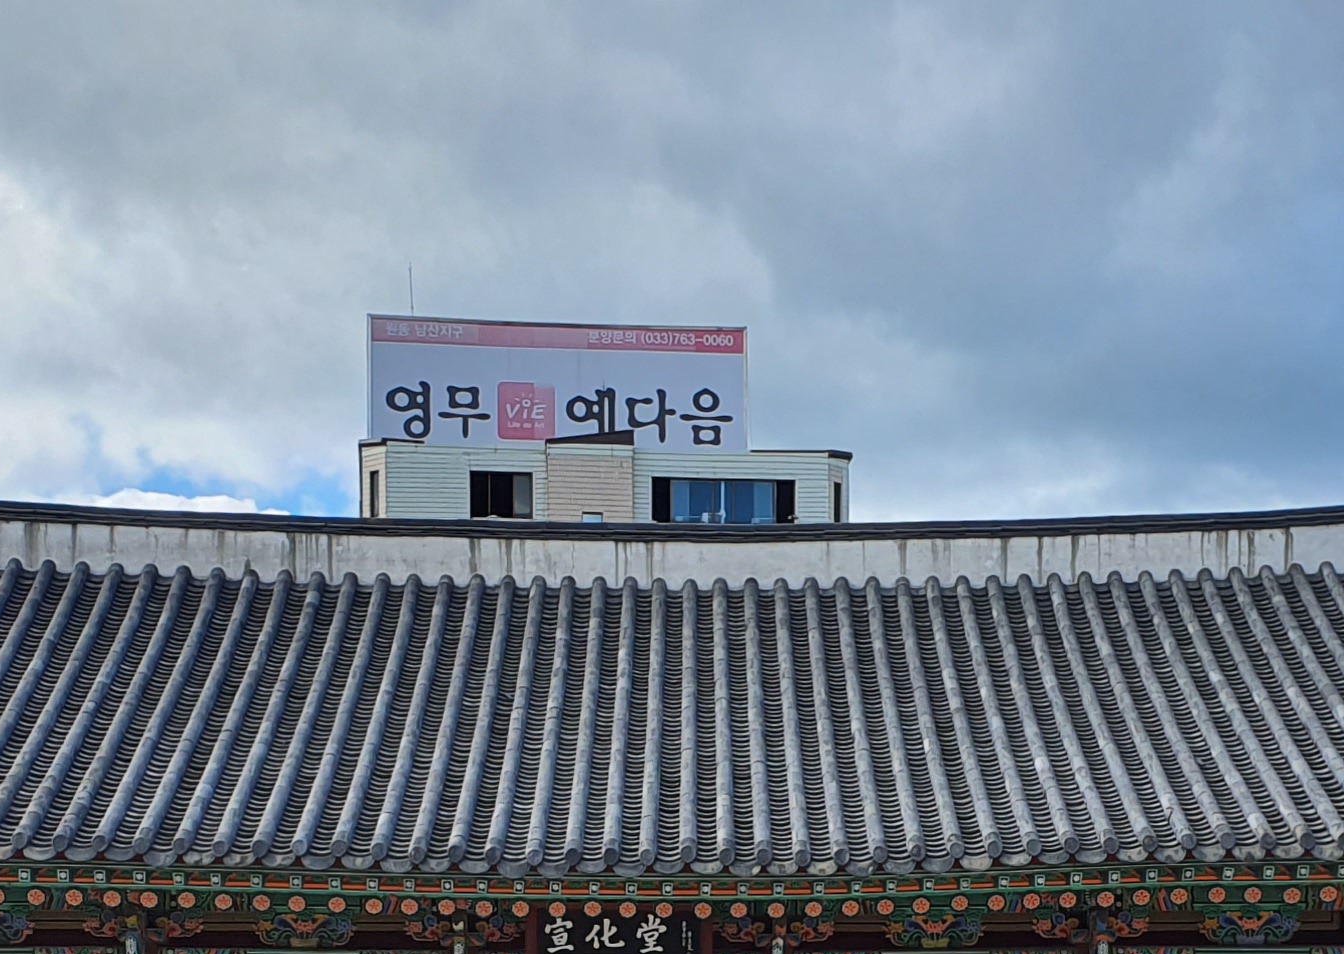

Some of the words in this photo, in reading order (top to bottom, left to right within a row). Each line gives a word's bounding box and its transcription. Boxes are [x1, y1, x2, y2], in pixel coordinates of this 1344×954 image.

[641, 332, 734, 347] (033)763-0060
[386, 381, 491, 439] 영무
[566, 387, 733, 446] 예다음
[544, 914, 667, 954] 宣化堂
